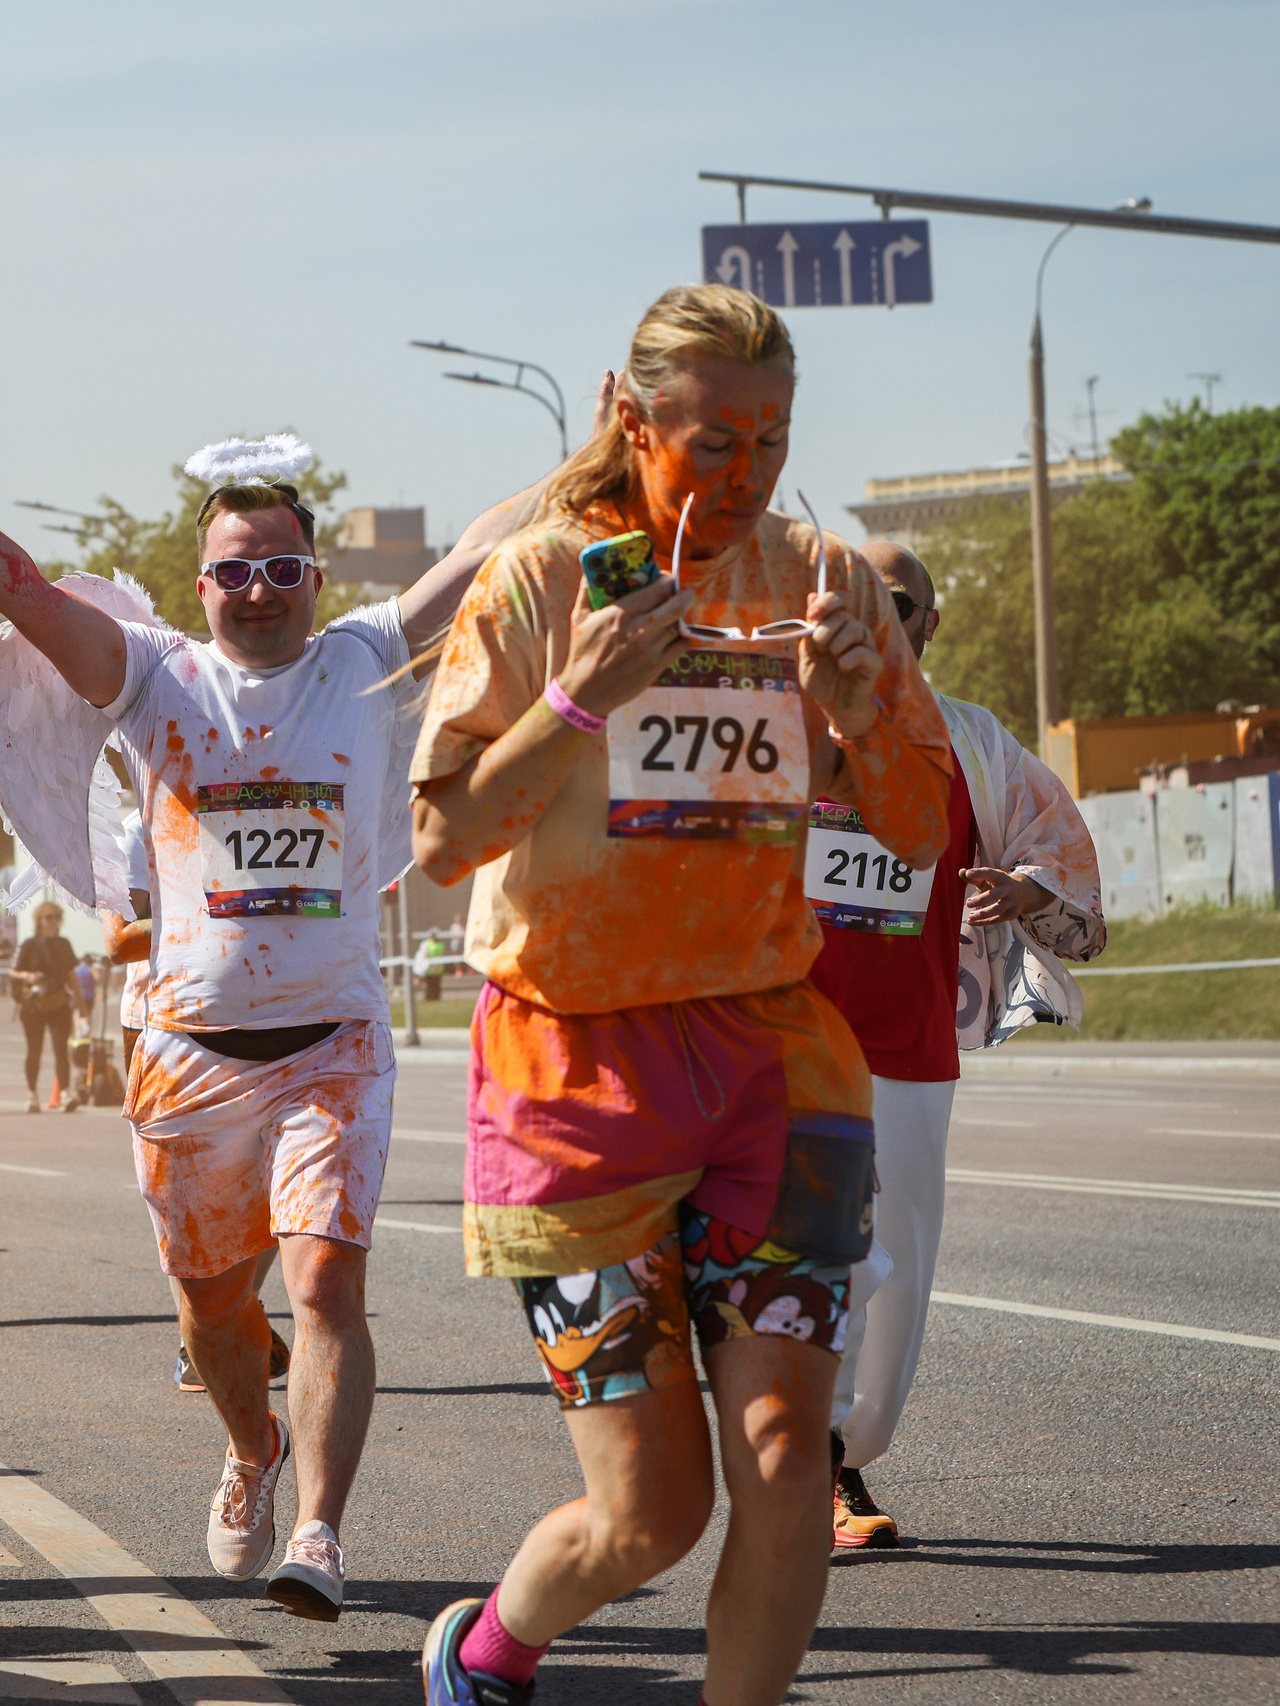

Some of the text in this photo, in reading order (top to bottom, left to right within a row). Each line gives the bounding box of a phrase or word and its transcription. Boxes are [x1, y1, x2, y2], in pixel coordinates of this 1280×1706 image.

[639, 714, 779, 774] 2796
[282, 799, 342, 811] 2026
[225, 828, 325, 871] 1227
[824, 848, 914, 894] 2118
